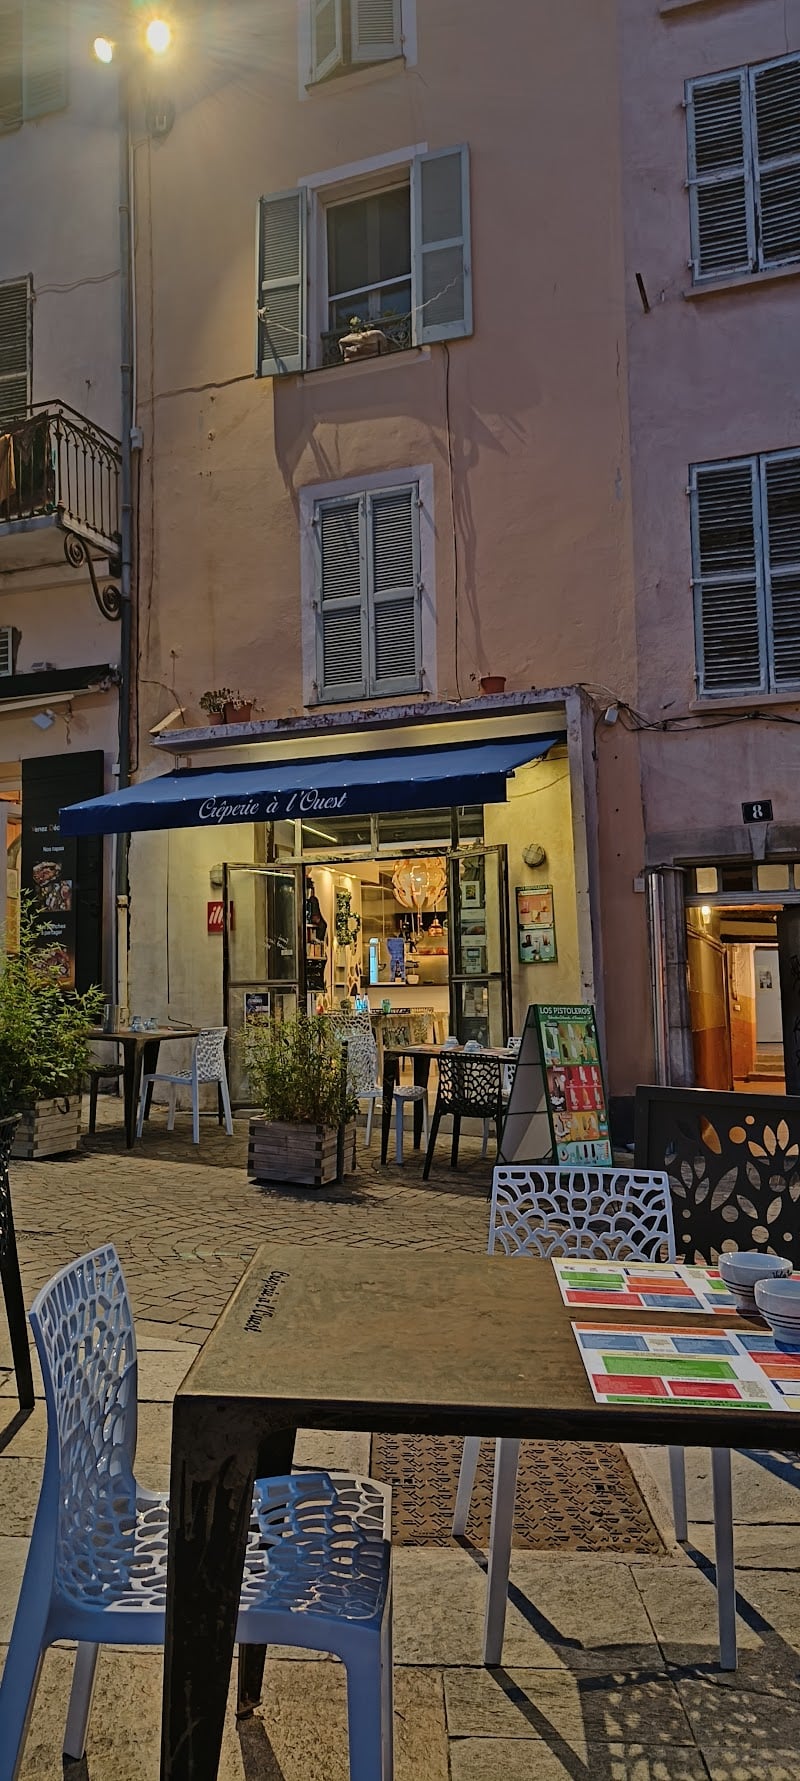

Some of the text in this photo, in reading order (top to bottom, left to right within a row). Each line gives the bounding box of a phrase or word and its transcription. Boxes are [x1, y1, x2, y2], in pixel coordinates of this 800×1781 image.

[199, 789, 348, 823] Crêperie à l'Ouest
[753, 804, 763, 819] 8
[553, 1007, 591, 1015] PISTOLEROS
